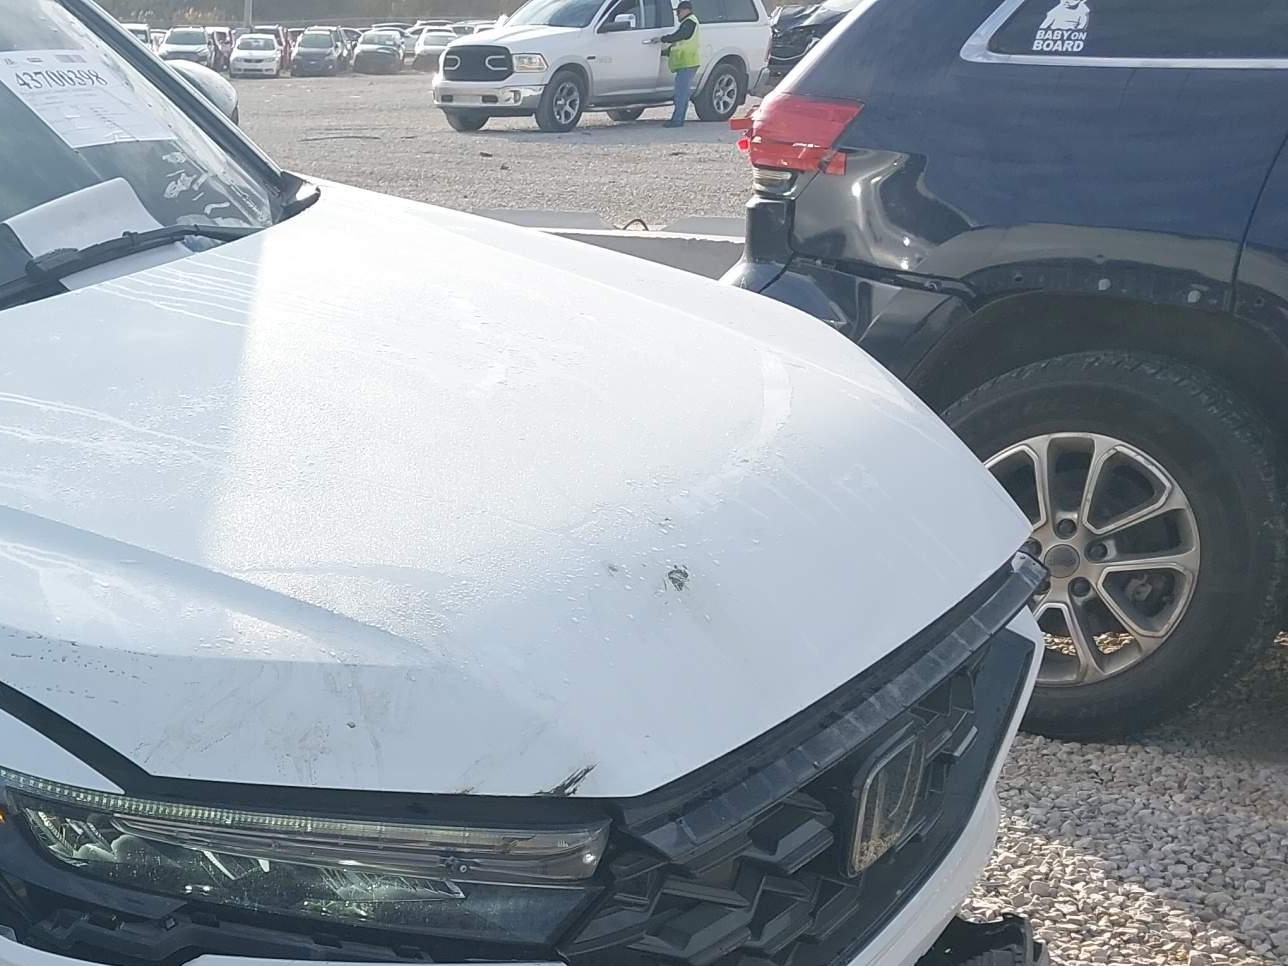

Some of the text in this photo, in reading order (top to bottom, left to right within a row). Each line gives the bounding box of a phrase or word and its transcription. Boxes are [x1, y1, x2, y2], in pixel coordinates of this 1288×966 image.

[1035, 30, 1087, 40] BABY ON
[1032, 40, 1084, 52] BOARD
[14, 69, 108, 90] 43700398
